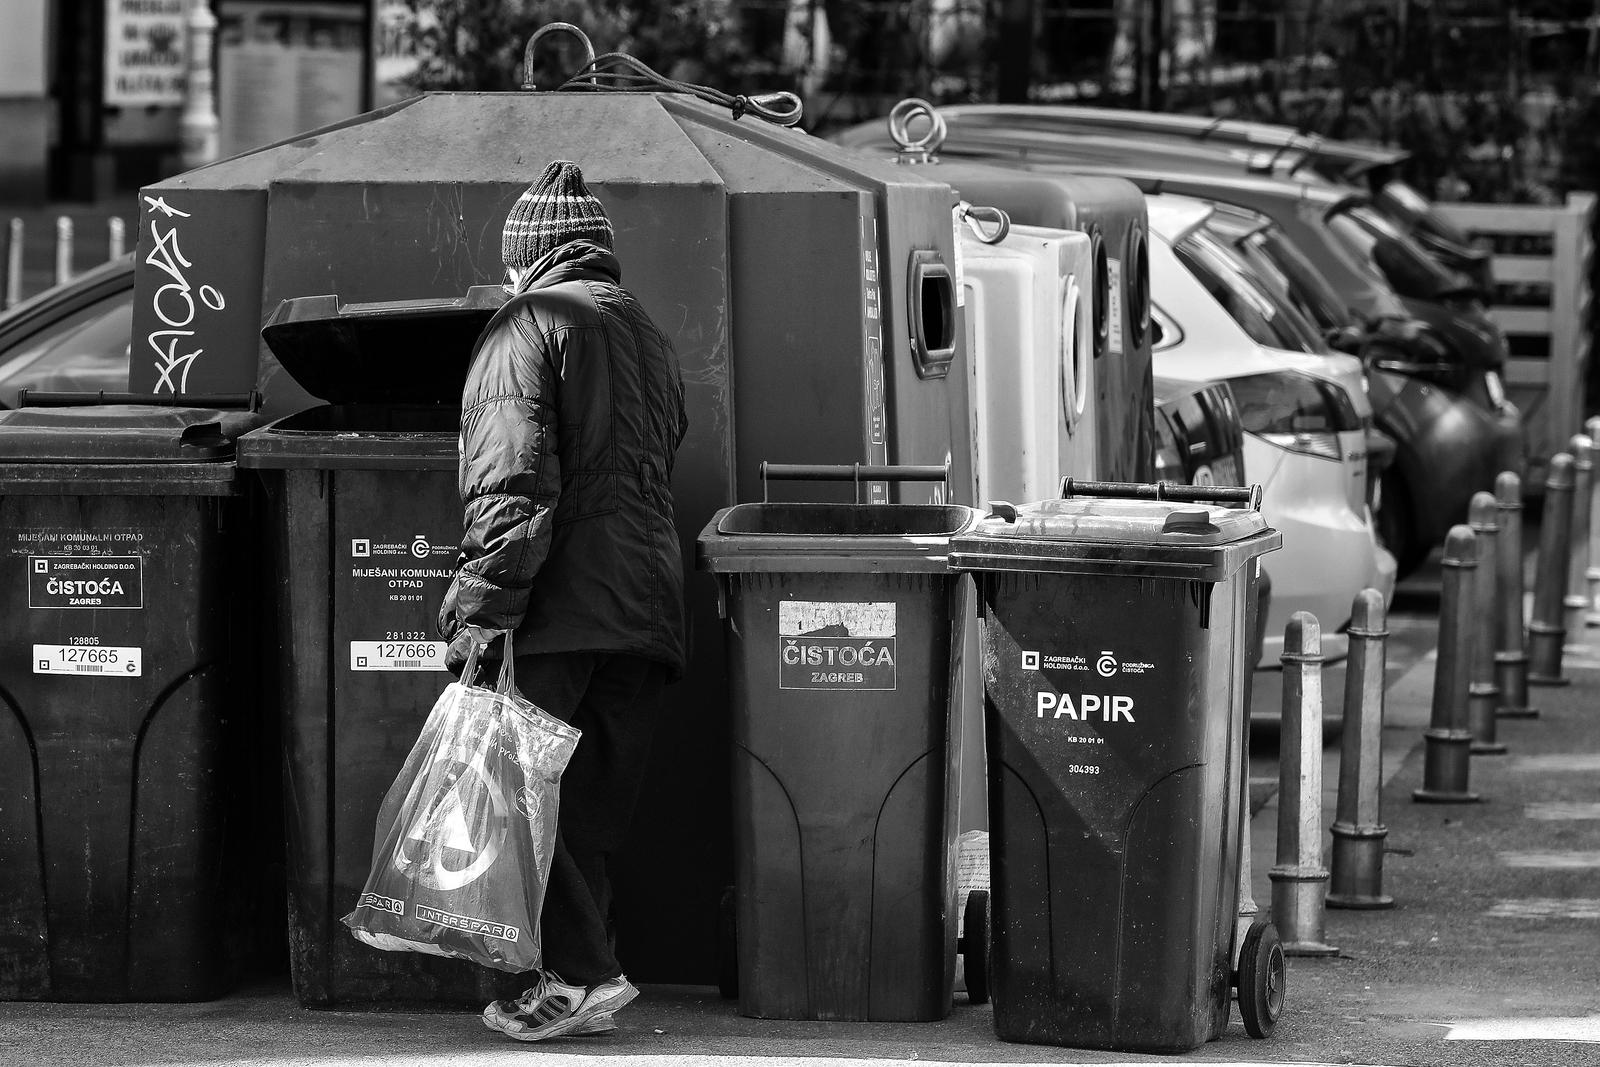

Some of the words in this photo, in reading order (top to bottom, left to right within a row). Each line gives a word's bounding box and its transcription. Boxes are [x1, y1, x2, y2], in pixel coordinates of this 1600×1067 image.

[60, 533, 113, 543] KOMUNALNI
[114, 533, 143, 542] OTPAD
[53, 562, 92, 570] ZAGREBAČKI
[352, 567, 397, 577] MIJEŠANI
[46, 577, 124, 595] ČISTOĆA
[388, 580, 424, 588] OTPAD
[69, 637, 100, 645] 128805
[386, 631, 426, 640] 281322
[58, 648, 119, 663] 127665
[376, 644, 436, 658] 127666
[782, 639, 894, 666] ČISTOĆA
[1043, 655, 1086, 664] ZAGREBAČKI
[811, 672, 864, 683] ZAGREB
[1037, 691, 1136, 723] PAPIR
[1068, 764, 1100, 775] 304393
[422, 908, 504, 937] INTERSPAR
